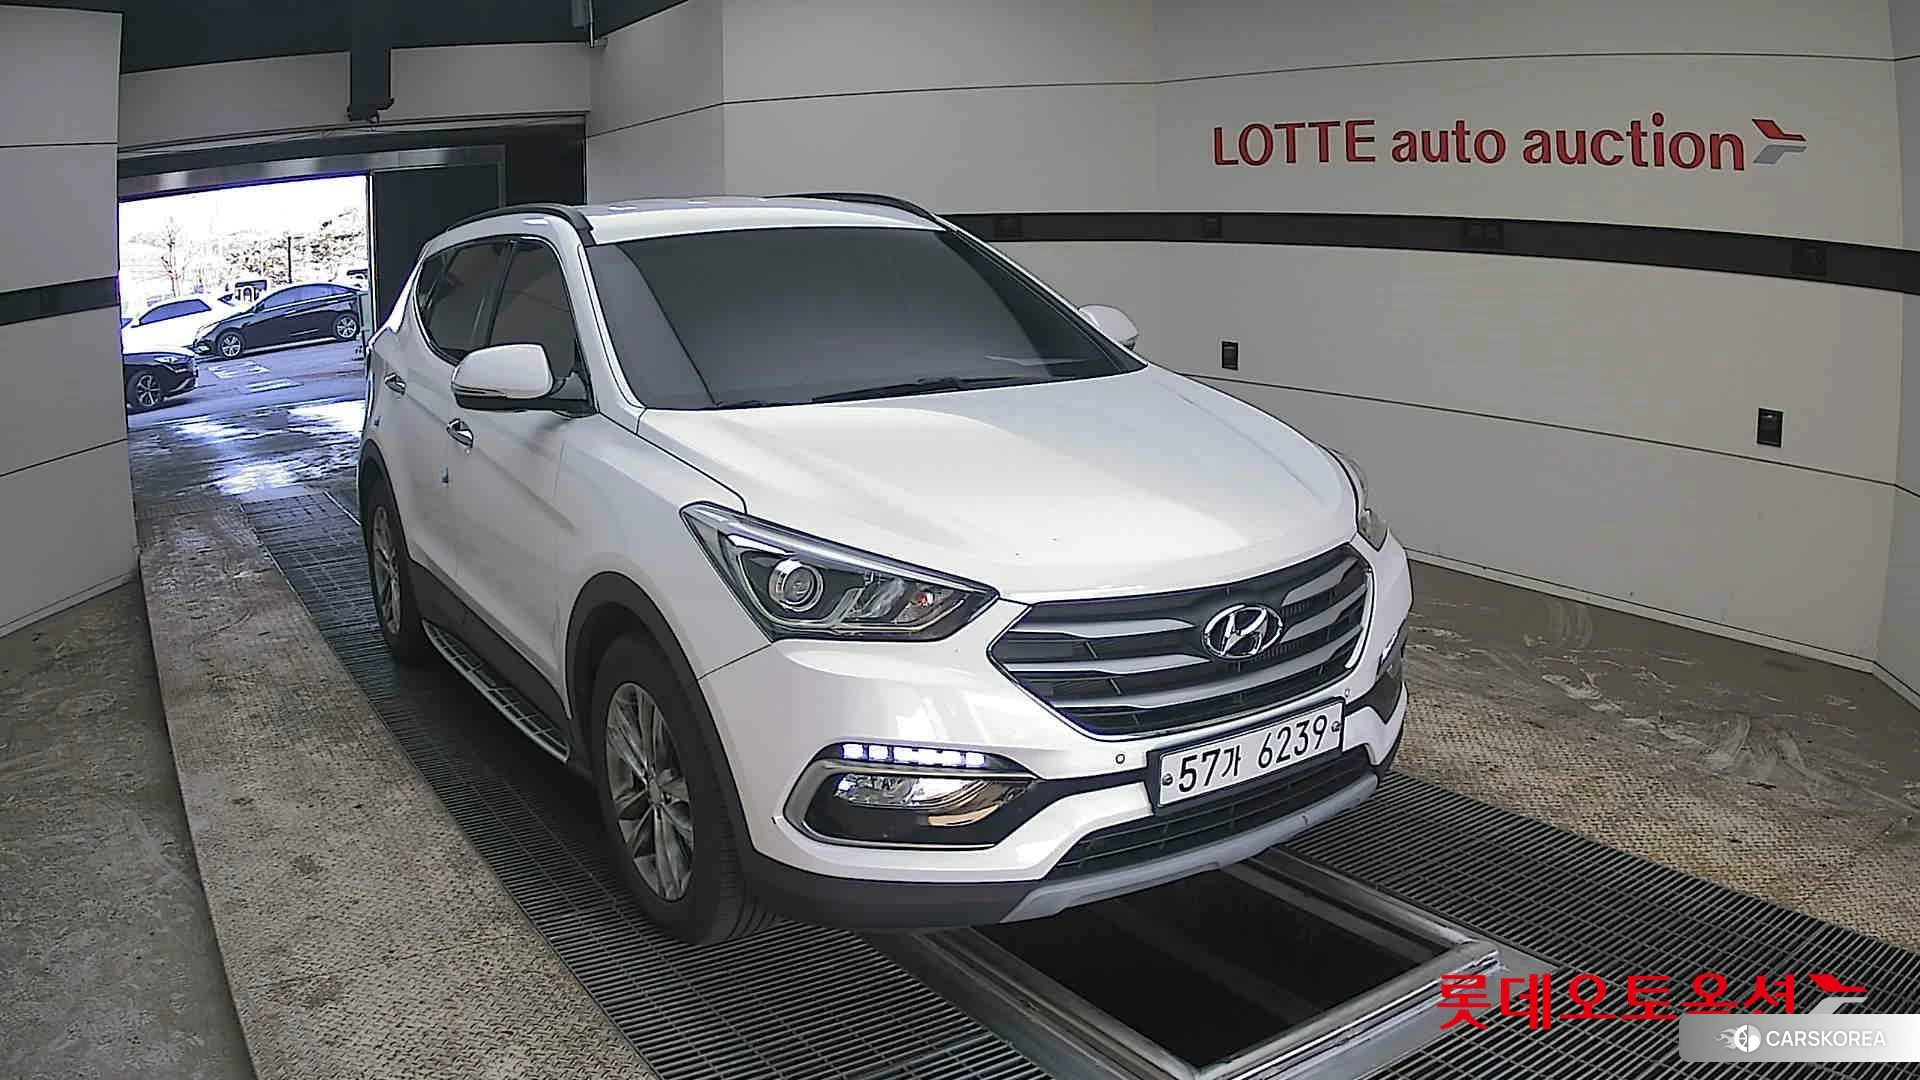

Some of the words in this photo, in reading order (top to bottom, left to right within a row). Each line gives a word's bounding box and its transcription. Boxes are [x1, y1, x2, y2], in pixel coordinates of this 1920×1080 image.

[1212, 119, 1377, 166] LOTTE
[1391, 119, 1508, 165] auto
[1522, 111, 1747, 172] auction
[1177, 744, 1243, 794] 57가
[1257, 713, 1329, 770] 6239
